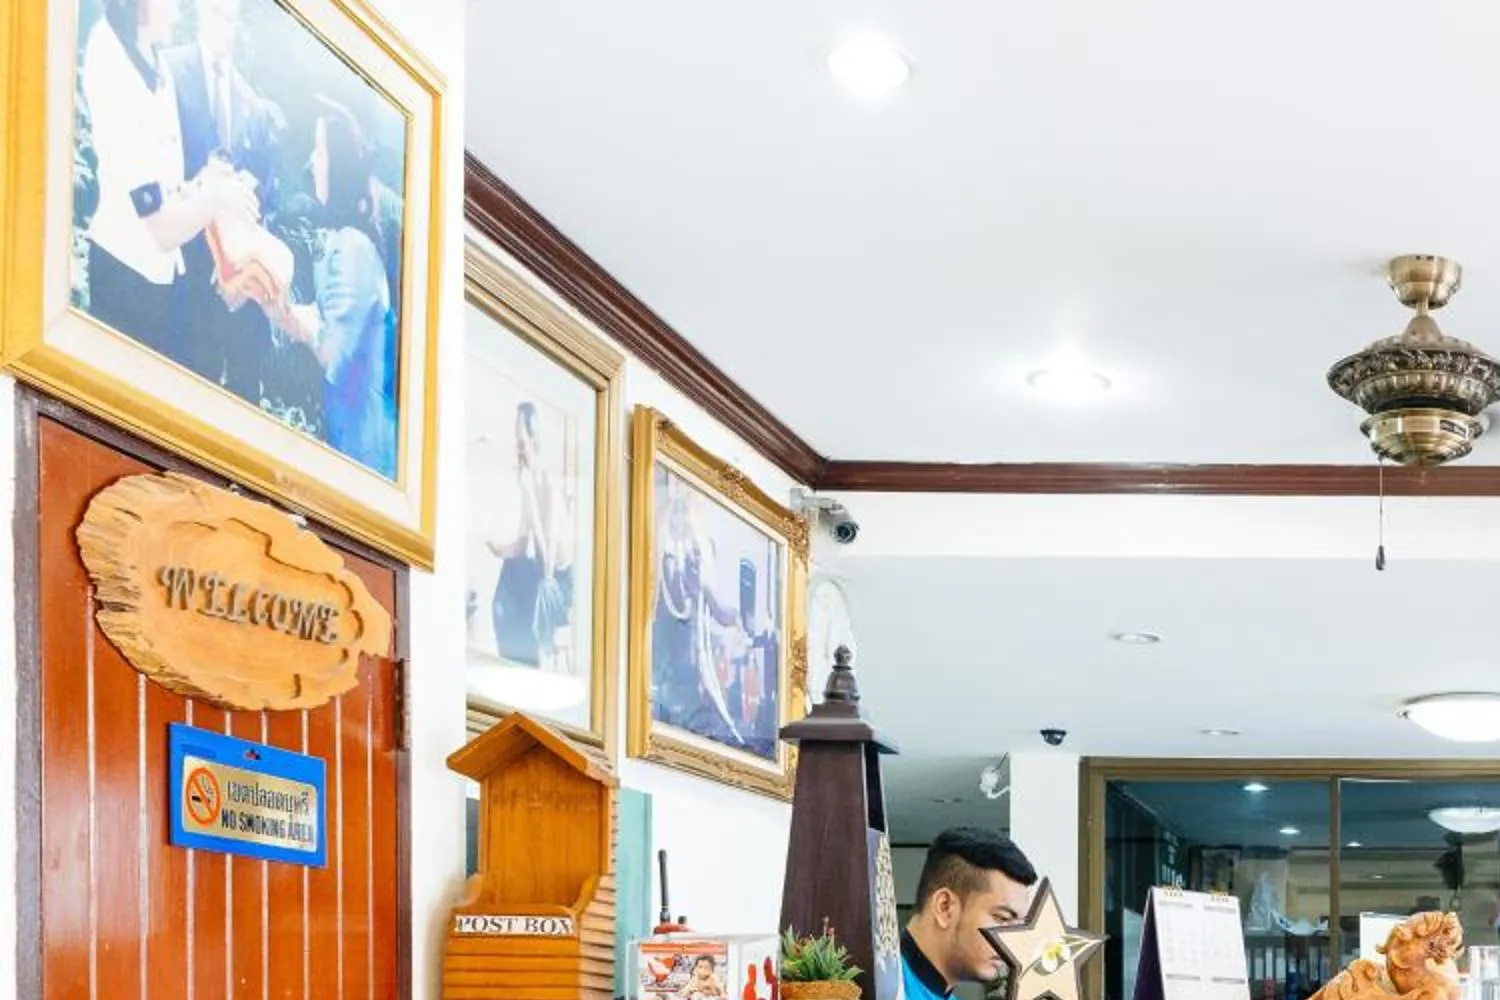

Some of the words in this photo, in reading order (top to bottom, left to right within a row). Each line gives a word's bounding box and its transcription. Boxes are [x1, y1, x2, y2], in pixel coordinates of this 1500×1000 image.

[156, 564, 339, 644] WELCOME
[221, 808, 237, 829] NO
[239, 811, 286, 838] SMOKING
[458, 917, 518, 933] POST
[524, 917, 573, 935] BOX
